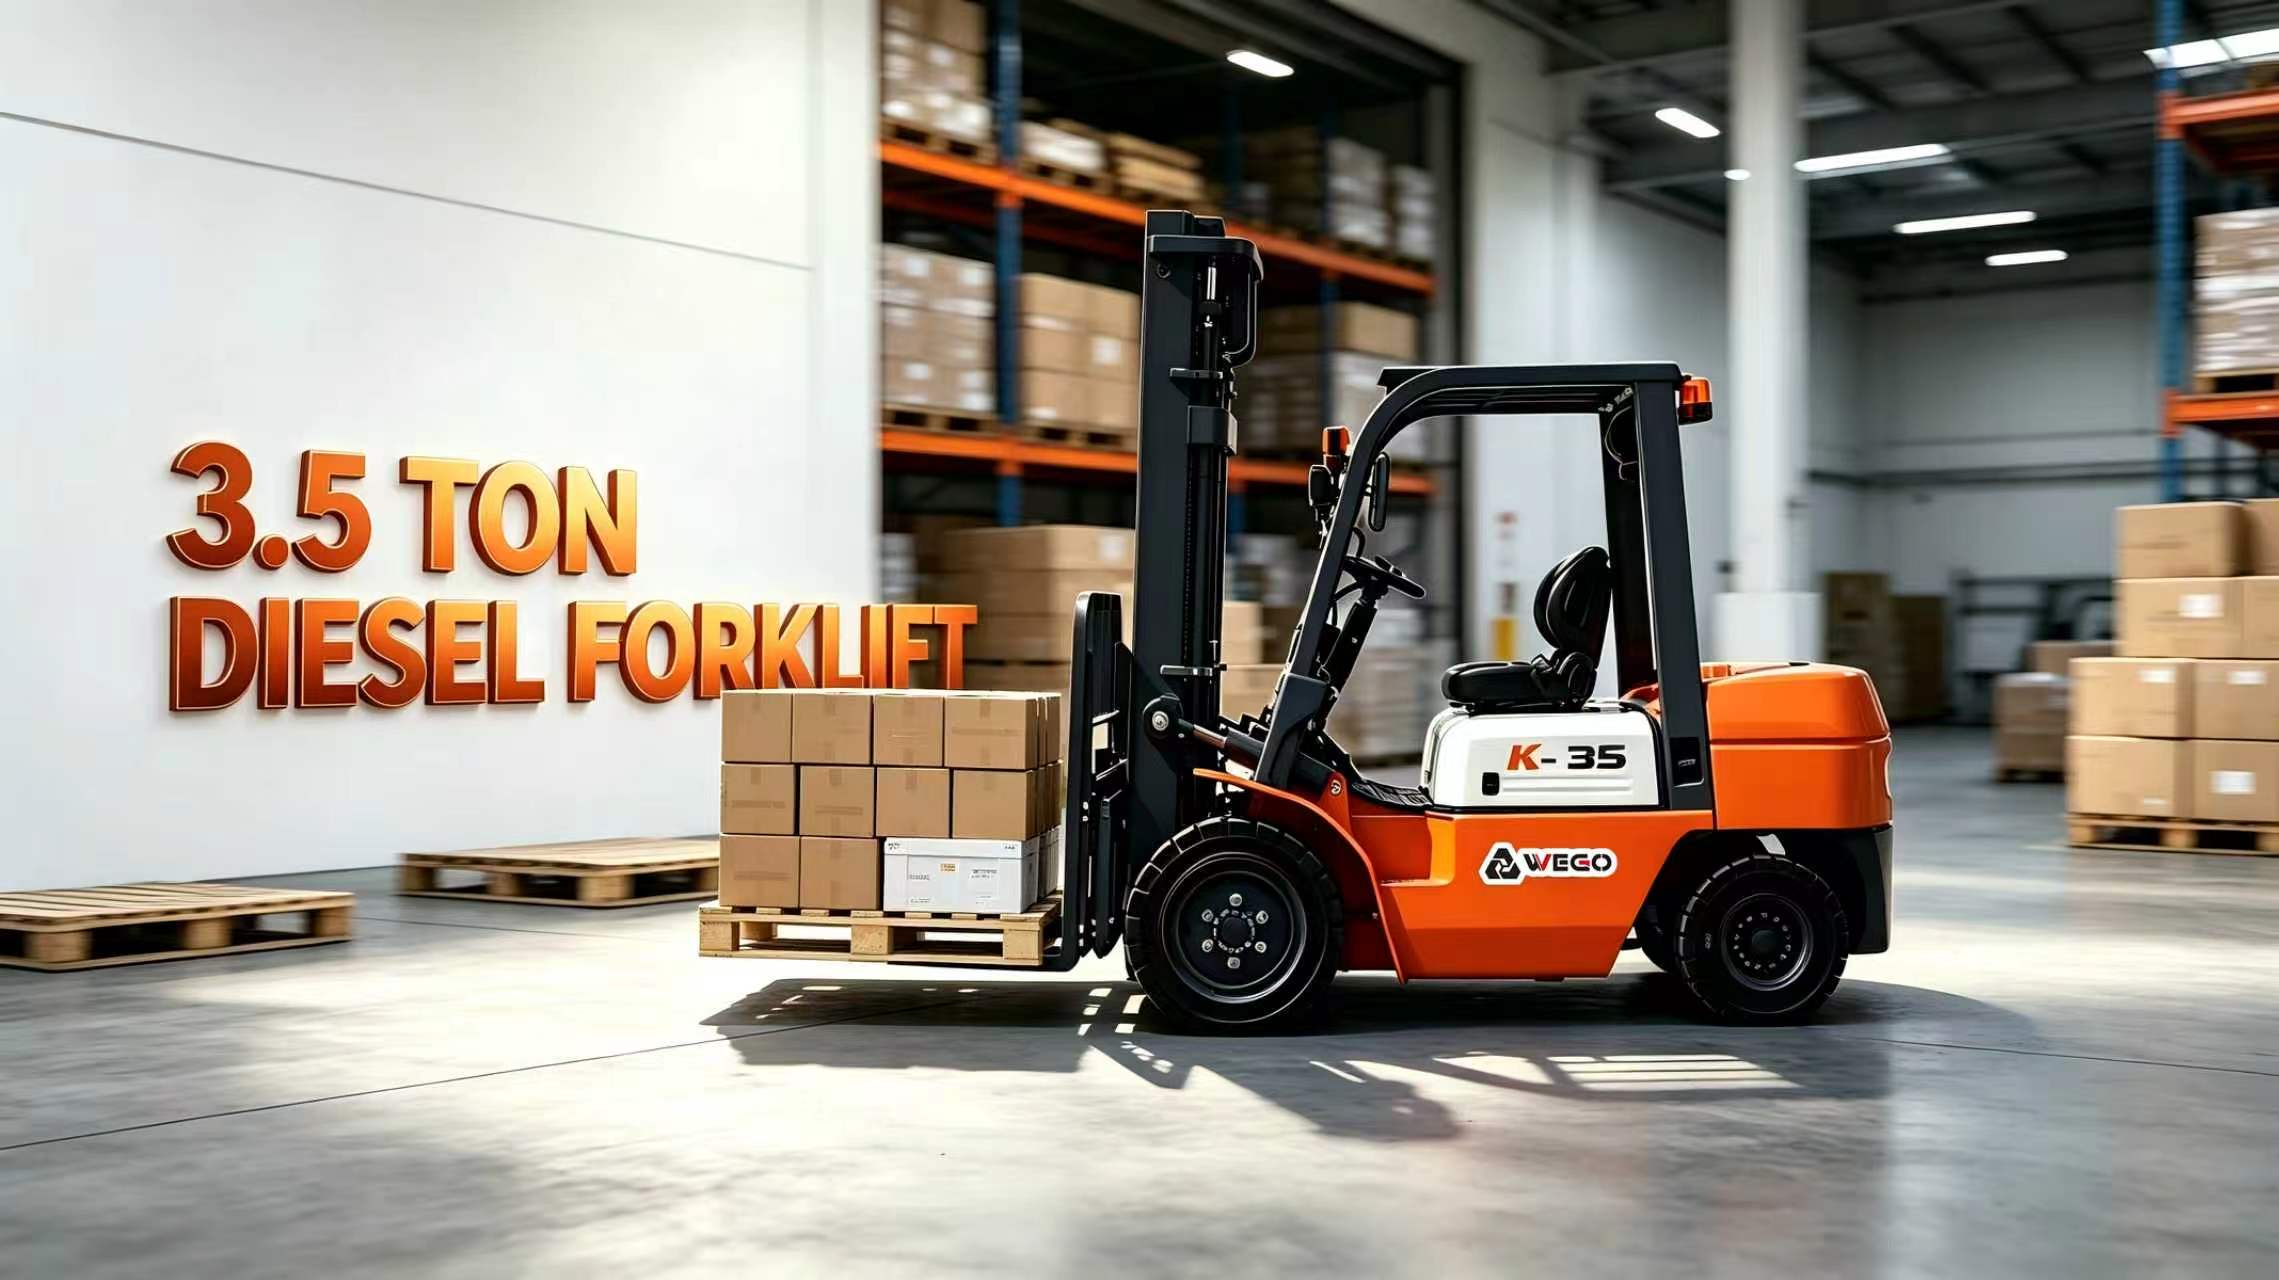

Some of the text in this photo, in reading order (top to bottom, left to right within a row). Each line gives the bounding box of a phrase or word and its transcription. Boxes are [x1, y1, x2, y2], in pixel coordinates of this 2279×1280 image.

[167, 441, 638, 577] 3.5 TON
[169, 596, 979, 712] DIESEL FORKLIFT
[1523, 853, 1612, 872] WEGO
